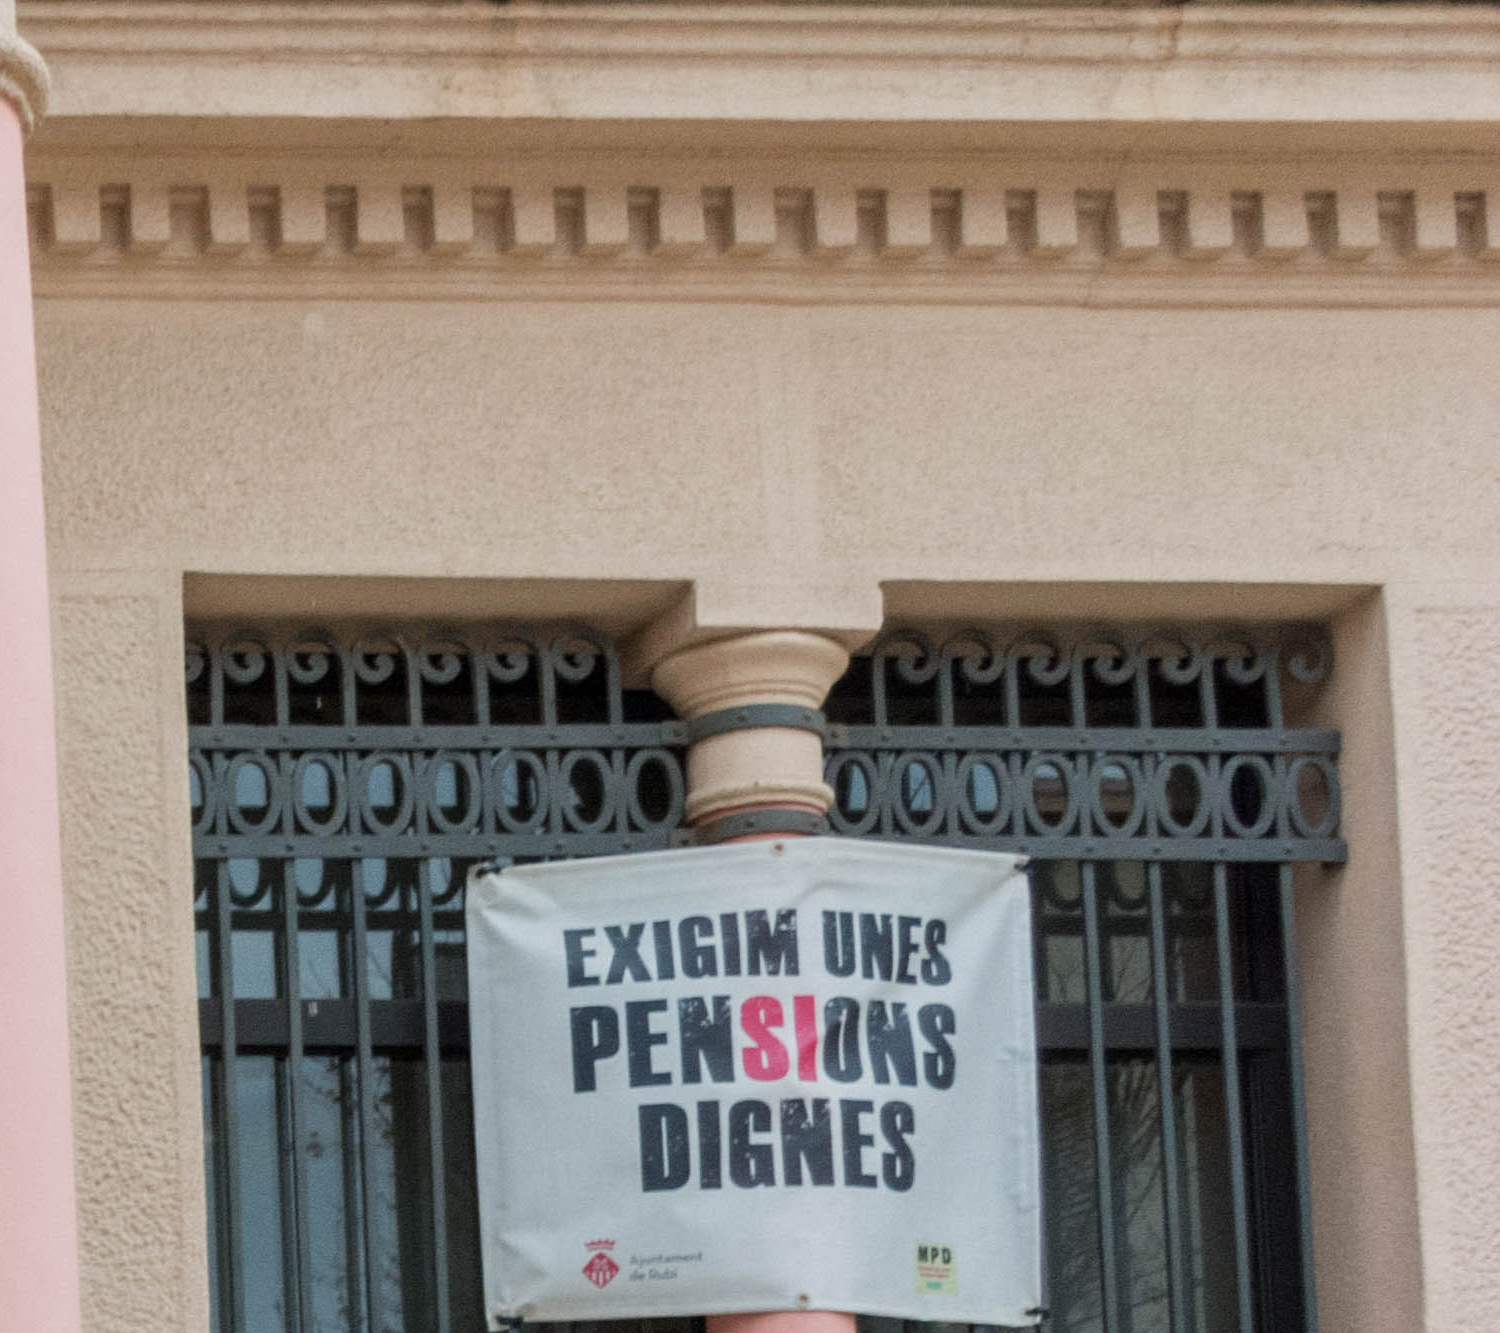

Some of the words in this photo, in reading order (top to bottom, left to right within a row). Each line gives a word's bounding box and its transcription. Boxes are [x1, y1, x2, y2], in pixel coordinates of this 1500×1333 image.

[563, 909, 800, 988] EXIGIM
[821, 909, 952, 987] UNES
[569, 994, 957, 1094] PENSIONS
[638, 1098, 916, 1193] DIGNES
[918, 1245, 952, 1264] MPD
